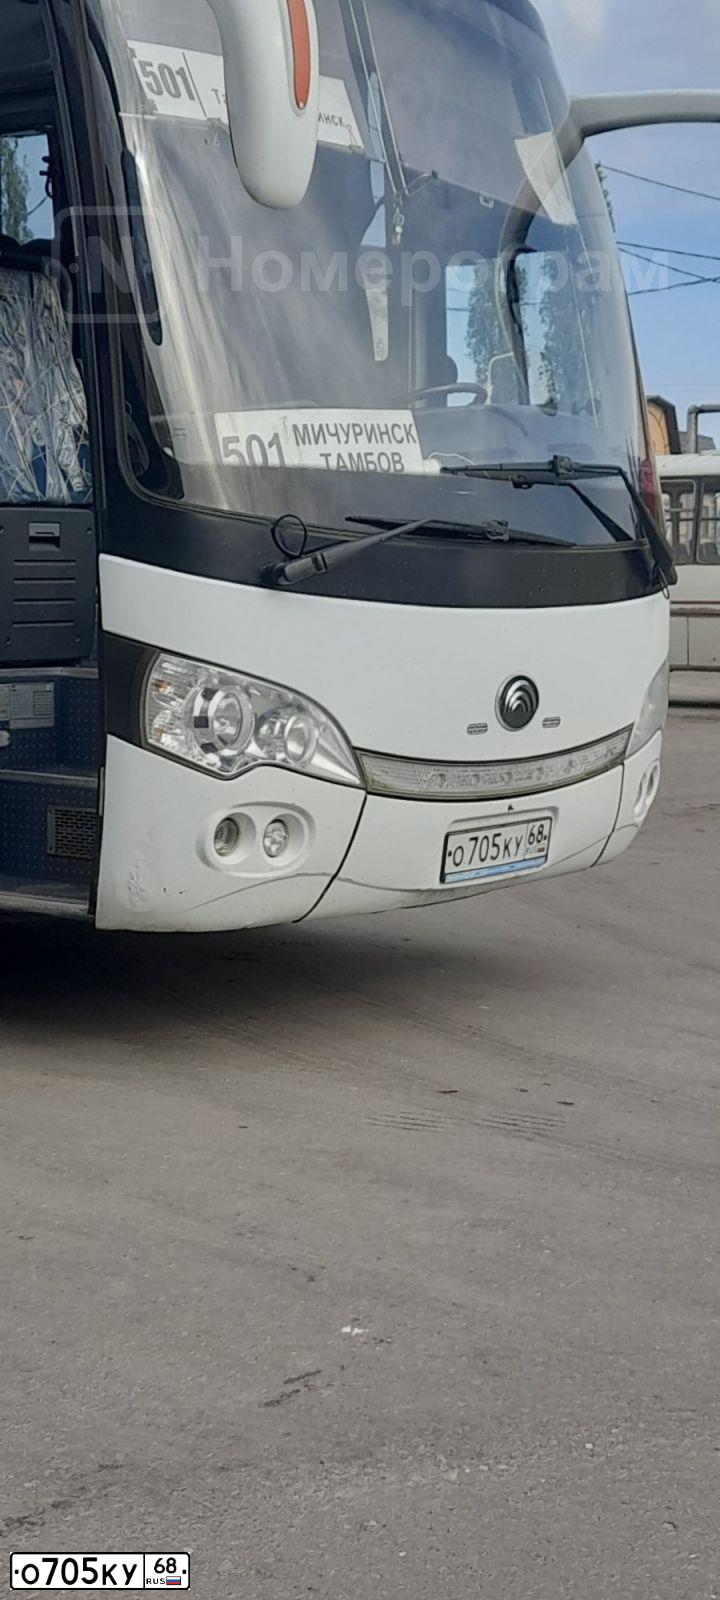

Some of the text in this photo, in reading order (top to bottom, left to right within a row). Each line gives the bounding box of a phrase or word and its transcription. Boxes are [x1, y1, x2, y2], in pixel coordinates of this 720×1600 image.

[138, 60, 195, 100] 501
[292, 423, 417, 446] МИЧУРИНСК
[222, 433, 286, 467] 501
[320, 452, 405, 472] ТАМБОВ
[527, 824, 545, 845] 68
